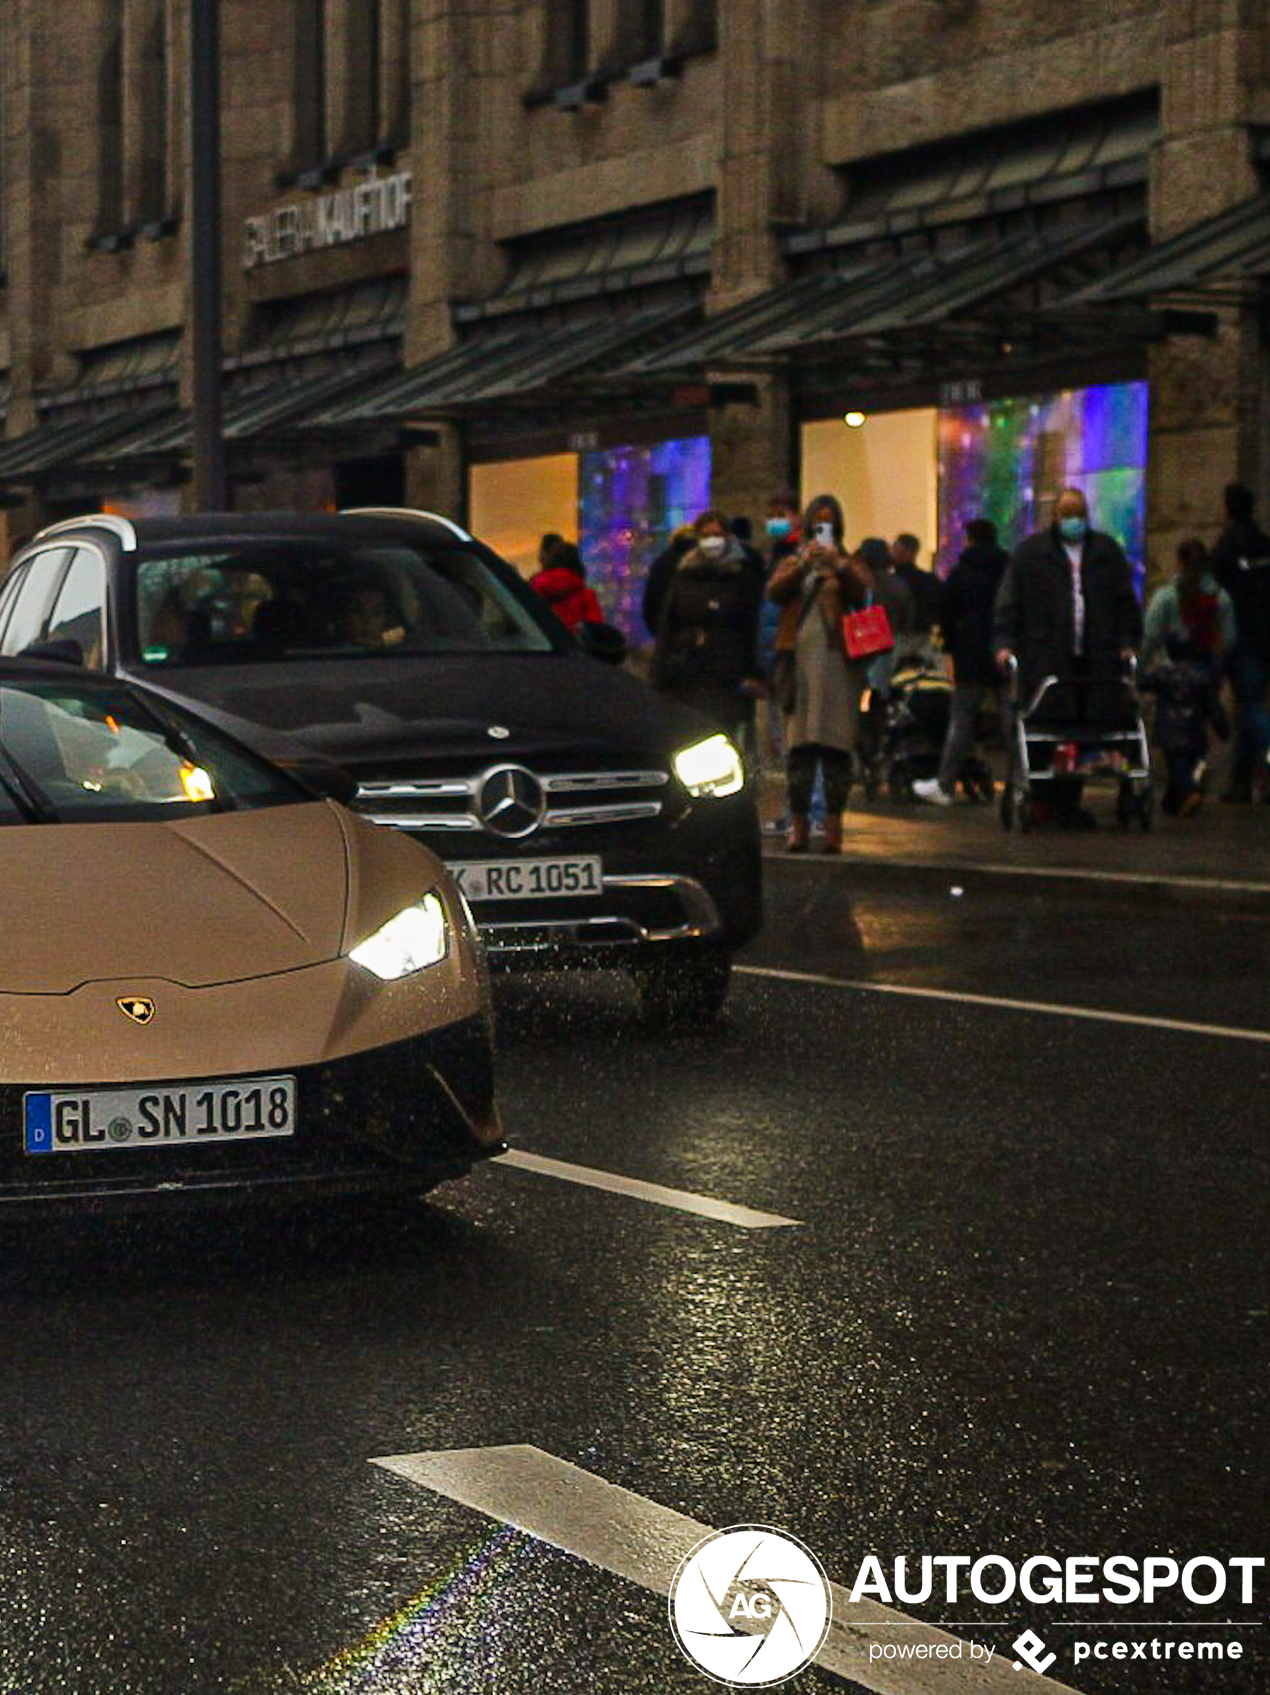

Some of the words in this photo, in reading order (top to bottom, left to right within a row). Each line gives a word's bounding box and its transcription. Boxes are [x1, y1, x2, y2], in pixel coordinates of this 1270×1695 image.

[487, 867, 523, 895] RC
[529, 863, 598, 893] 1051
[55, 1100, 105, 1144] GL
[138, 1093, 187, 1138] SN
[196, 1087, 289, 1135] 1018
